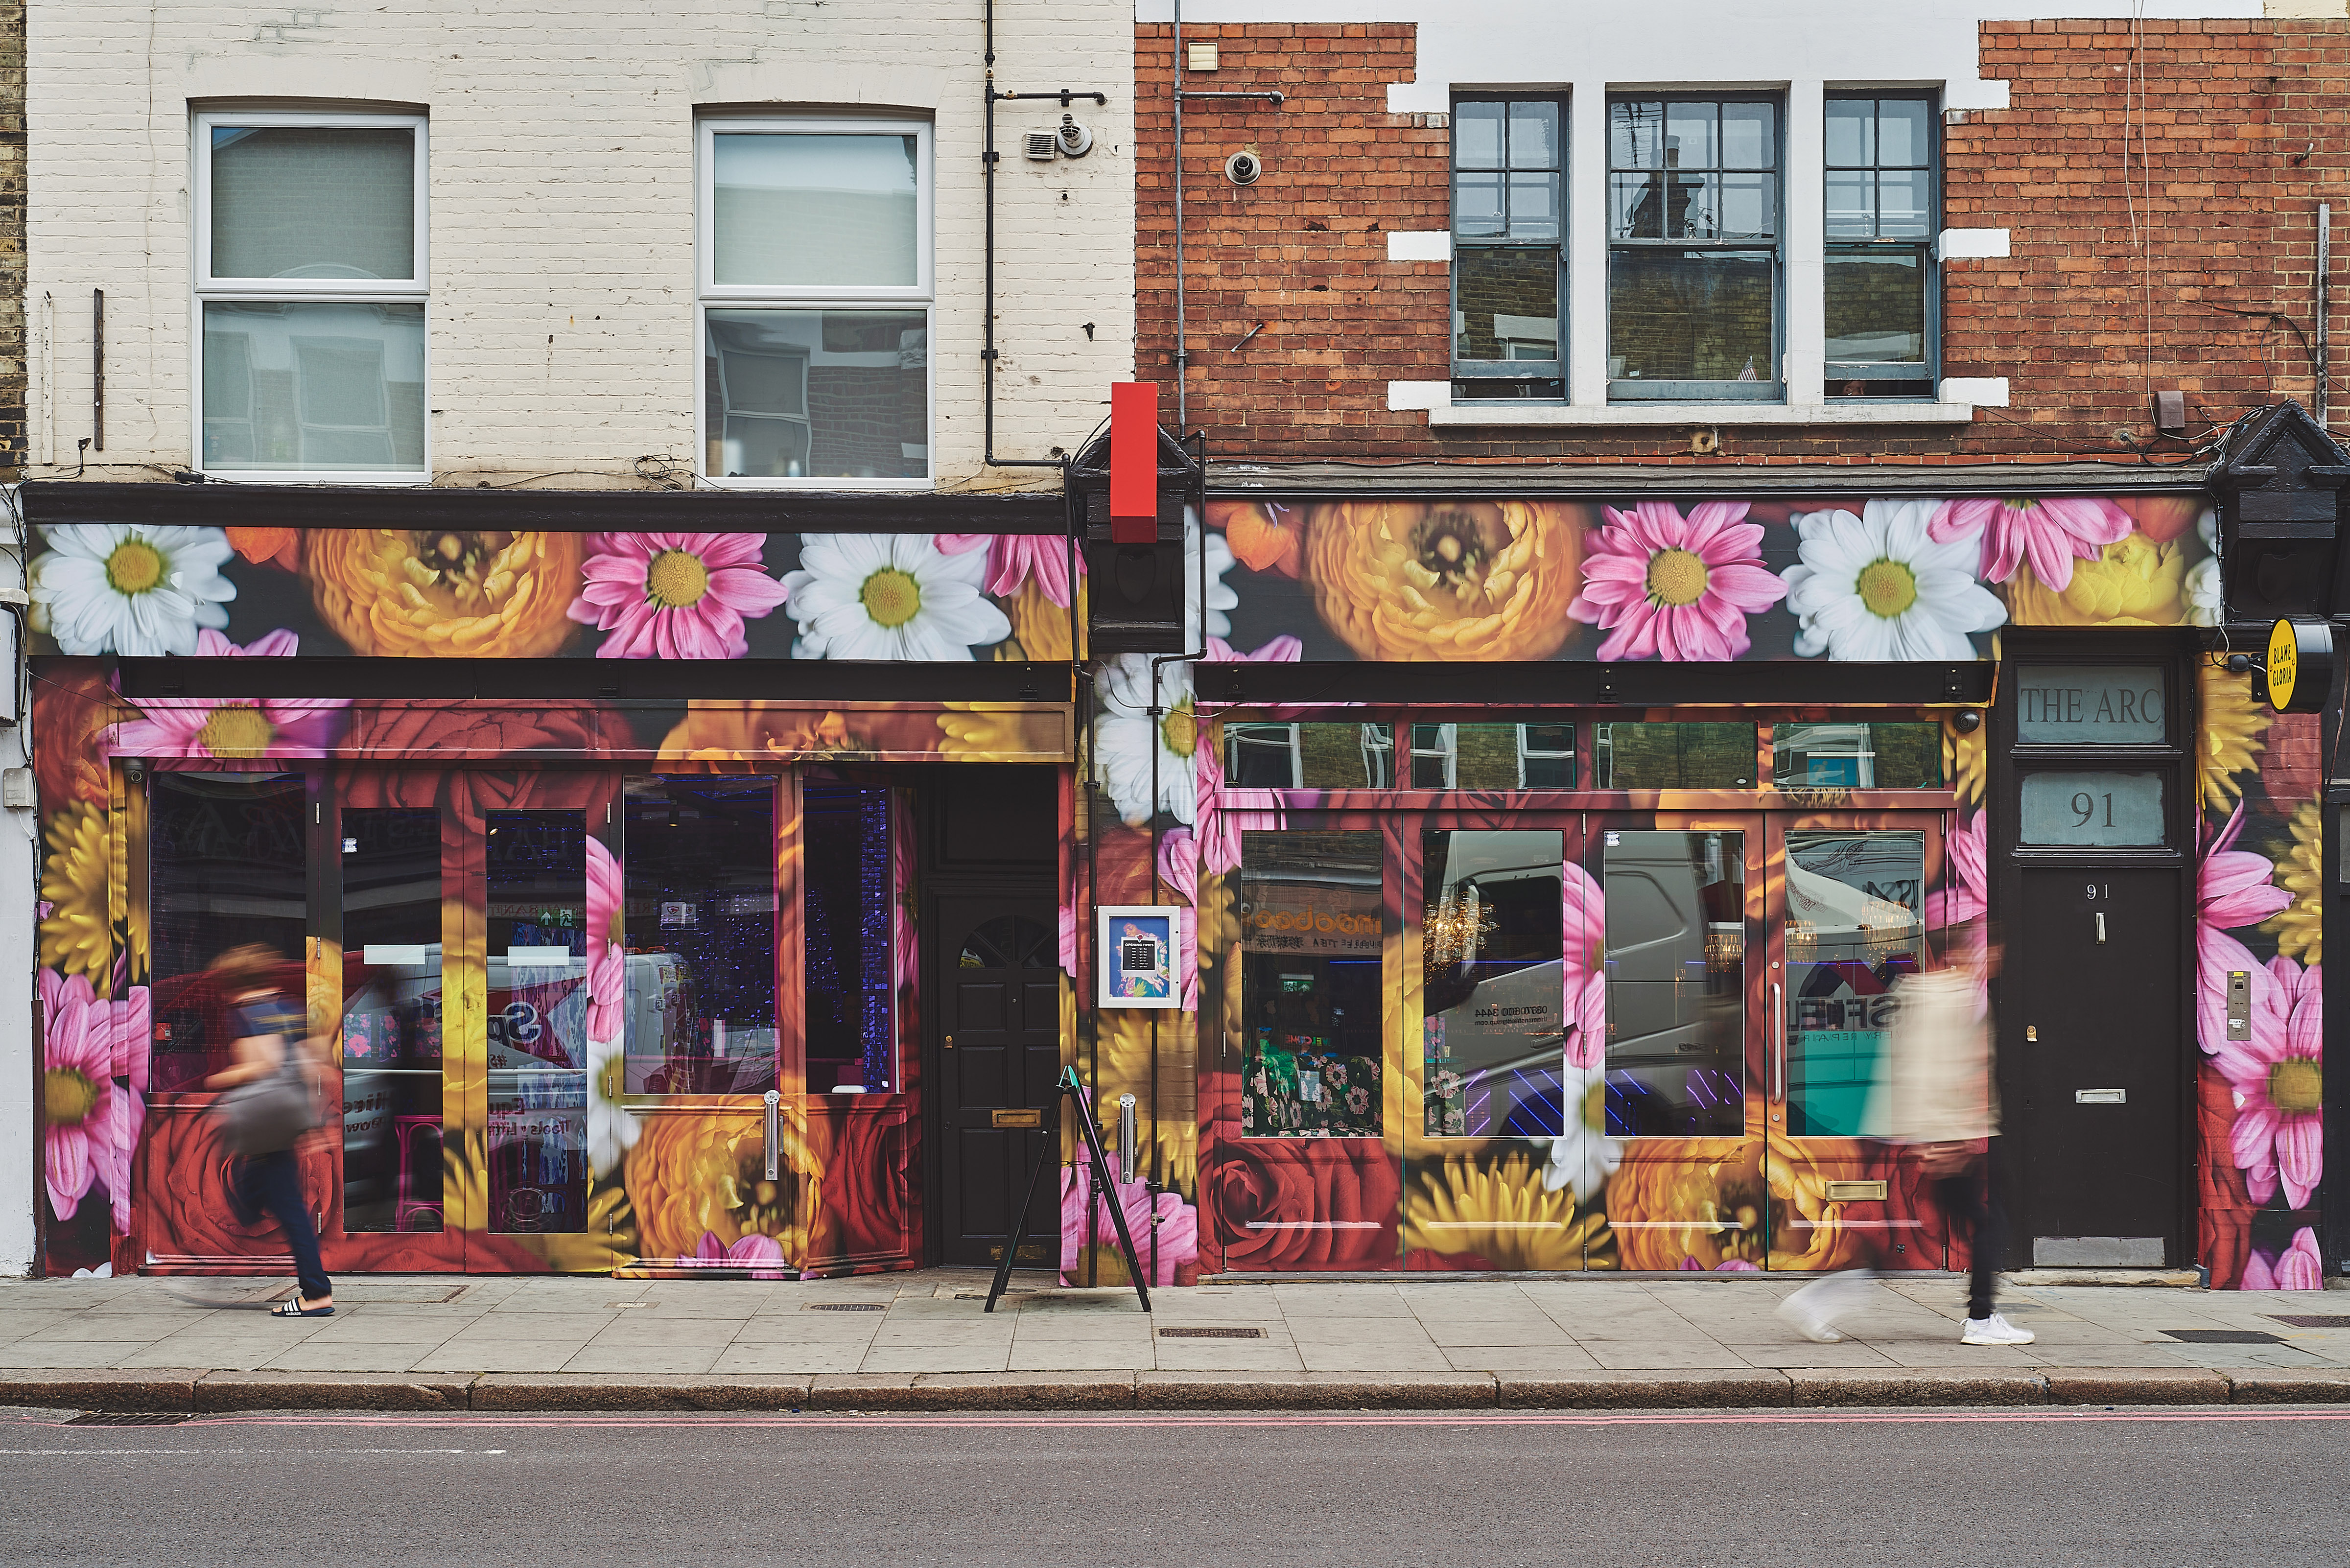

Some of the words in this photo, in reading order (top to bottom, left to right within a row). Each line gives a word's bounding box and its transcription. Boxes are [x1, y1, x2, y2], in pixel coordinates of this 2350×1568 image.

[2274, 643, 2291, 665] BLAME
[2273, 666, 2292, 687] GLORIA
[2021, 687, 2085, 723] THE
[2094, 687, 2162, 724] ARC
[2071, 792, 2116, 827] 91
[2086, 884, 2110, 900] 91
